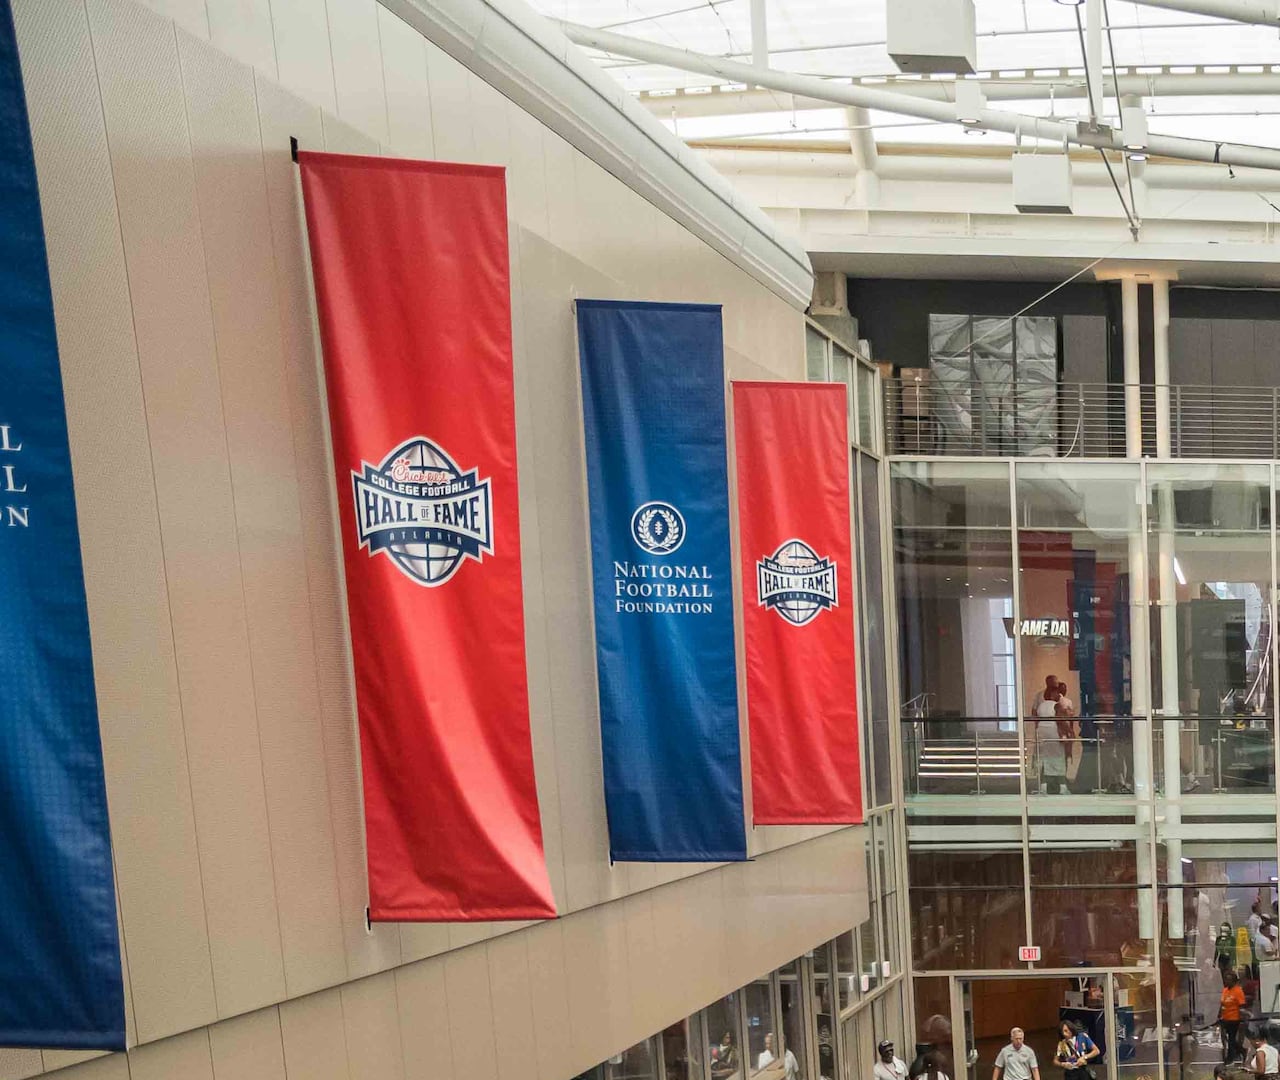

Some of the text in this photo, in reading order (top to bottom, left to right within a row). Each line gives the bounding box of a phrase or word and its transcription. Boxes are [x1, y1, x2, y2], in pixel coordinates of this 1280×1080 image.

[371, 473, 470, 497] COLLEGE FOOTBALL
[363, 489, 481, 535] HALL OF FAME
[389, 530, 462, 546] ATLANTA
[613, 561, 712, 579] NATIONAL
[615, 580, 713, 598] FOOTBALL
[764, 573, 831, 594] HALL FAME
[615, 599, 713, 614] FOUNDATION
